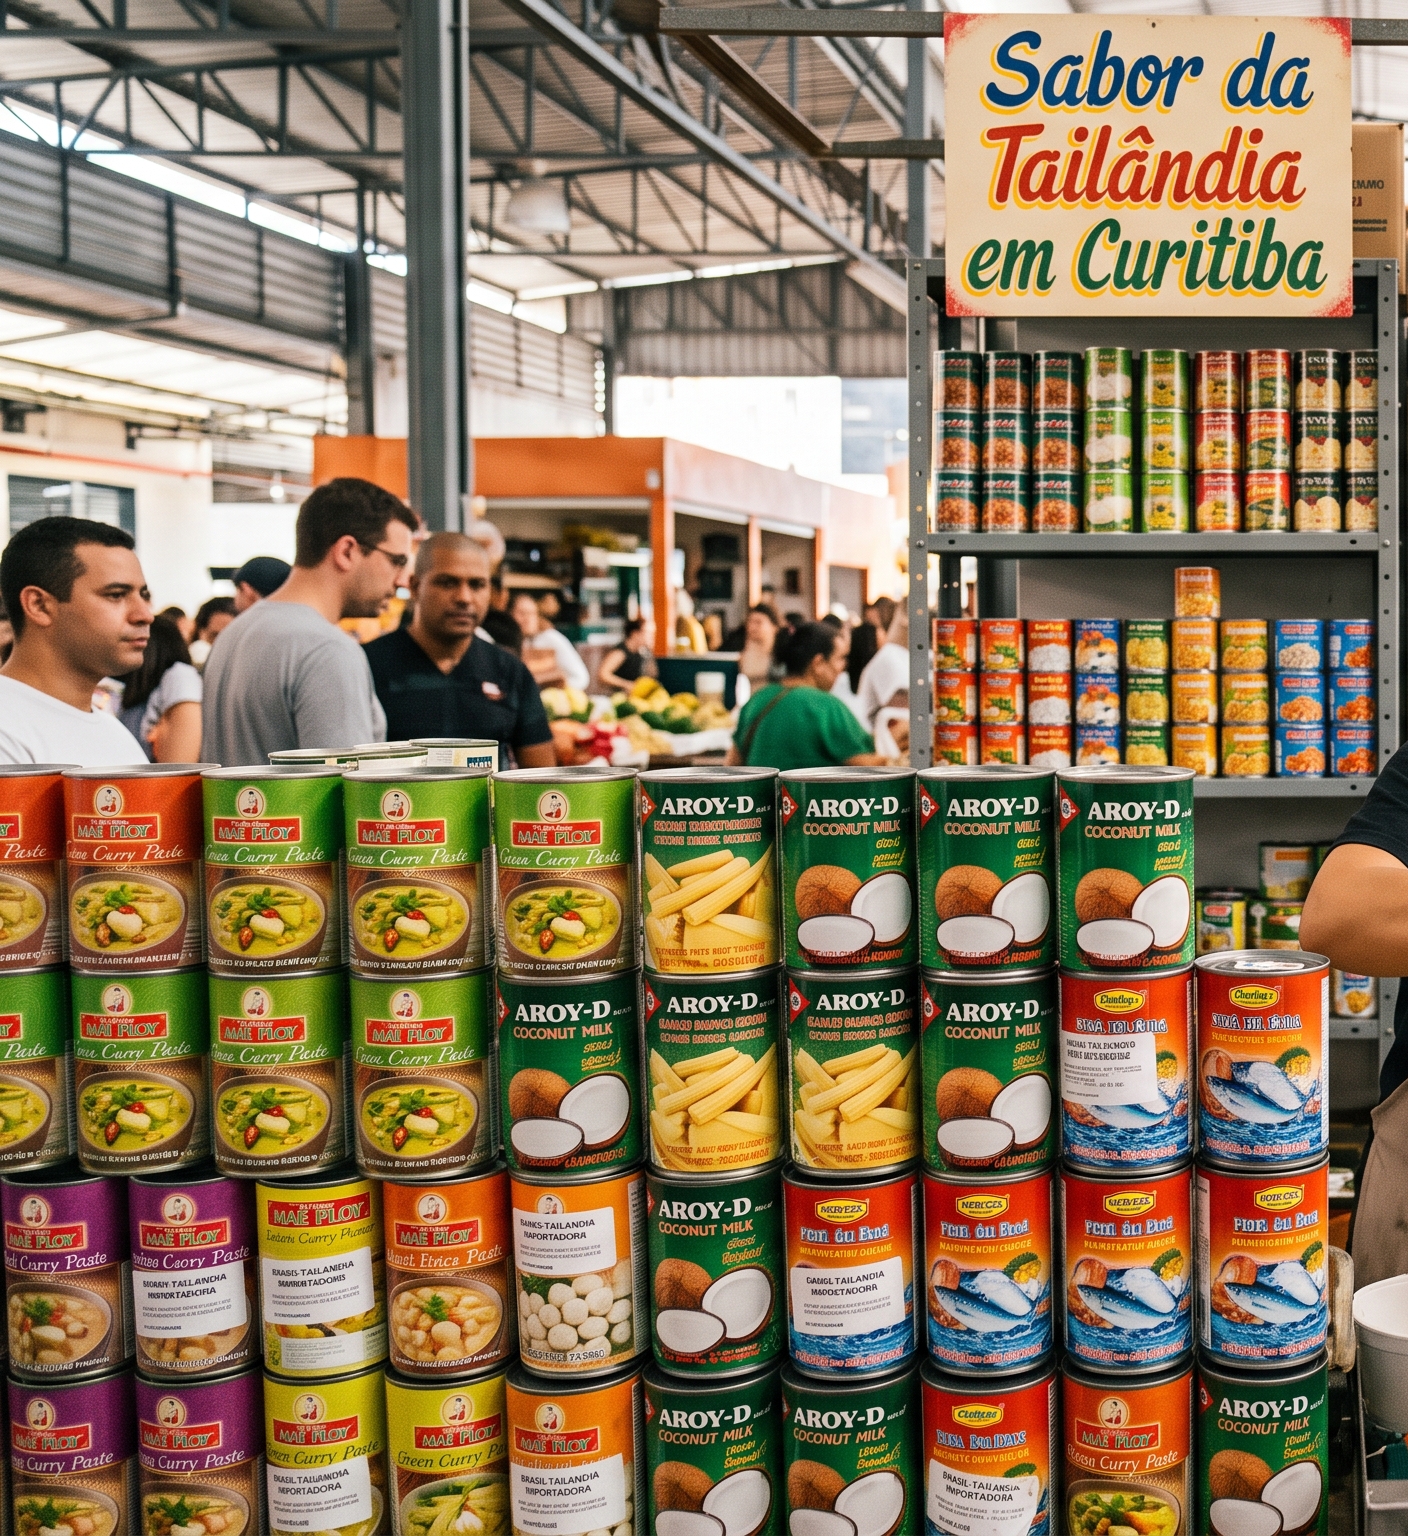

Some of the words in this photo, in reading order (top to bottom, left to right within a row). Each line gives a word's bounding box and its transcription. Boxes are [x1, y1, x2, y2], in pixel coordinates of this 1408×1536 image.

[982, 30, 1204, 112] Sabor
[1222, 31, 1314, 112] da
[981, 124, 1306, 208] Tailândia
[962, 238, 1056, 294] em
[1072, 217, 1327, 297] Curitiba
[661, 796, 754, 816] AROY-D
[806, 796, 899, 817] AROY-D
[947, 797, 1039, 818] AROY-D
[1088, 800, 1180, 821] AROY-D
[803, 822, 870, 836] COCONUT
[944, 822, 1010, 836] COCONUT
[1084, 824, 1150, 839] COCONUT
[667, 992, 758, 1014] AROY-D
[816, 988, 905, 1011] AROY-D
[515, 1000, 611, 1023] AROY-D
[946, 999, 1039, 1022] AROY-D
[513, 1026, 575, 1040] COCONUT
[582, 1023, 613, 1038] MILK
[944, 1026, 1010, 1040] COCONUT
[1015, 1022, 1041, 1036] MILK
[659, 1198, 751, 1221] AROY-D
[659, 1221, 717, 1236] COCONUT
[722, 1220, 754, 1233] MILK
[659, 1405, 751, 1429] AROY-D
[794, 1406, 885, 1429] AROY-D
[1219, 1395, 1308, 1419] AROY-D
[658, 1429, 718, 1445] COCONUT
[722, 1424, 753, 1442] MILK
[793, 1428, 850, 1445] COCONUT
[855, 1426, 886, 1444] MILK
[1217, 1418, 1279, 1434] COCONUT
[1283, 1416, 1311, 1432] MILK
[158, 1456, 198, 1476] Curry
[205, 1450, 245, 1469] Paste
[293, 1451, 337, 1465] Curry
[343, 1441, 379, 1460] Paste
[398, 1450, 433, 1468] Green
[440, 1452, 482, 1468] Curry
[27, 1455, 65, 1478] Curry
[1100, 1455, 1140, 1478] Curry
[1145, 1451, 1178, 1469] Paste
[521, 1474, 547, 1486] BRASIL
[548, 1471, 600, 1486] TAILANDIA
